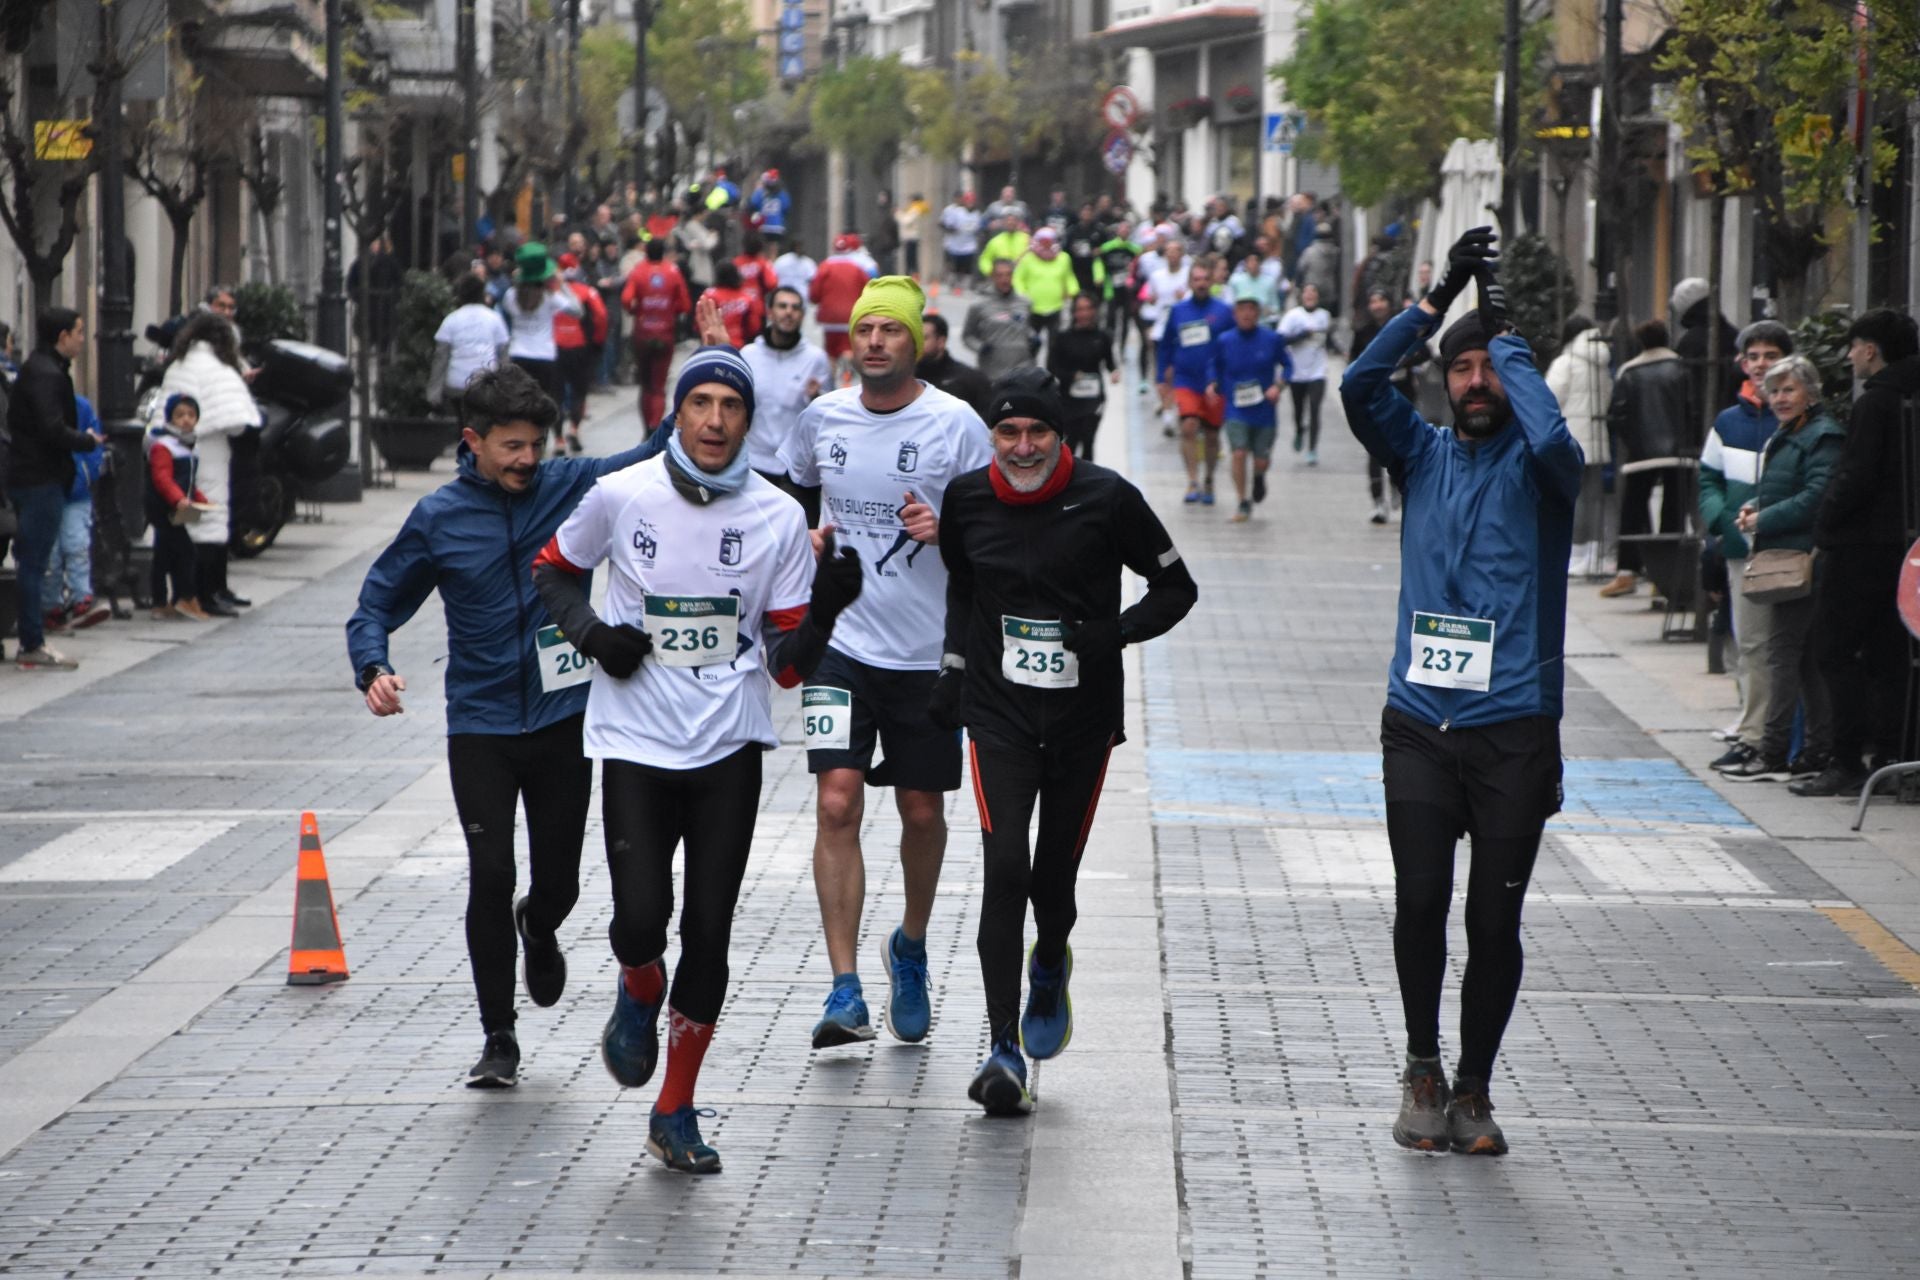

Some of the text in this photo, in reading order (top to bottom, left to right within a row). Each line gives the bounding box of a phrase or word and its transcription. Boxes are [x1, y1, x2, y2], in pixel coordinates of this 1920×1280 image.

[845, 498, 895, 519] SILVESTRE
[660, 625, 719, 652] 236
[555, 649, 594, 675] 20
[1015, 648, 1065, 674] 235
[1421, 646, 1474, 674] 237
[703, 672, 718, 680] 2024
[803, 715, 834, 737] 50
